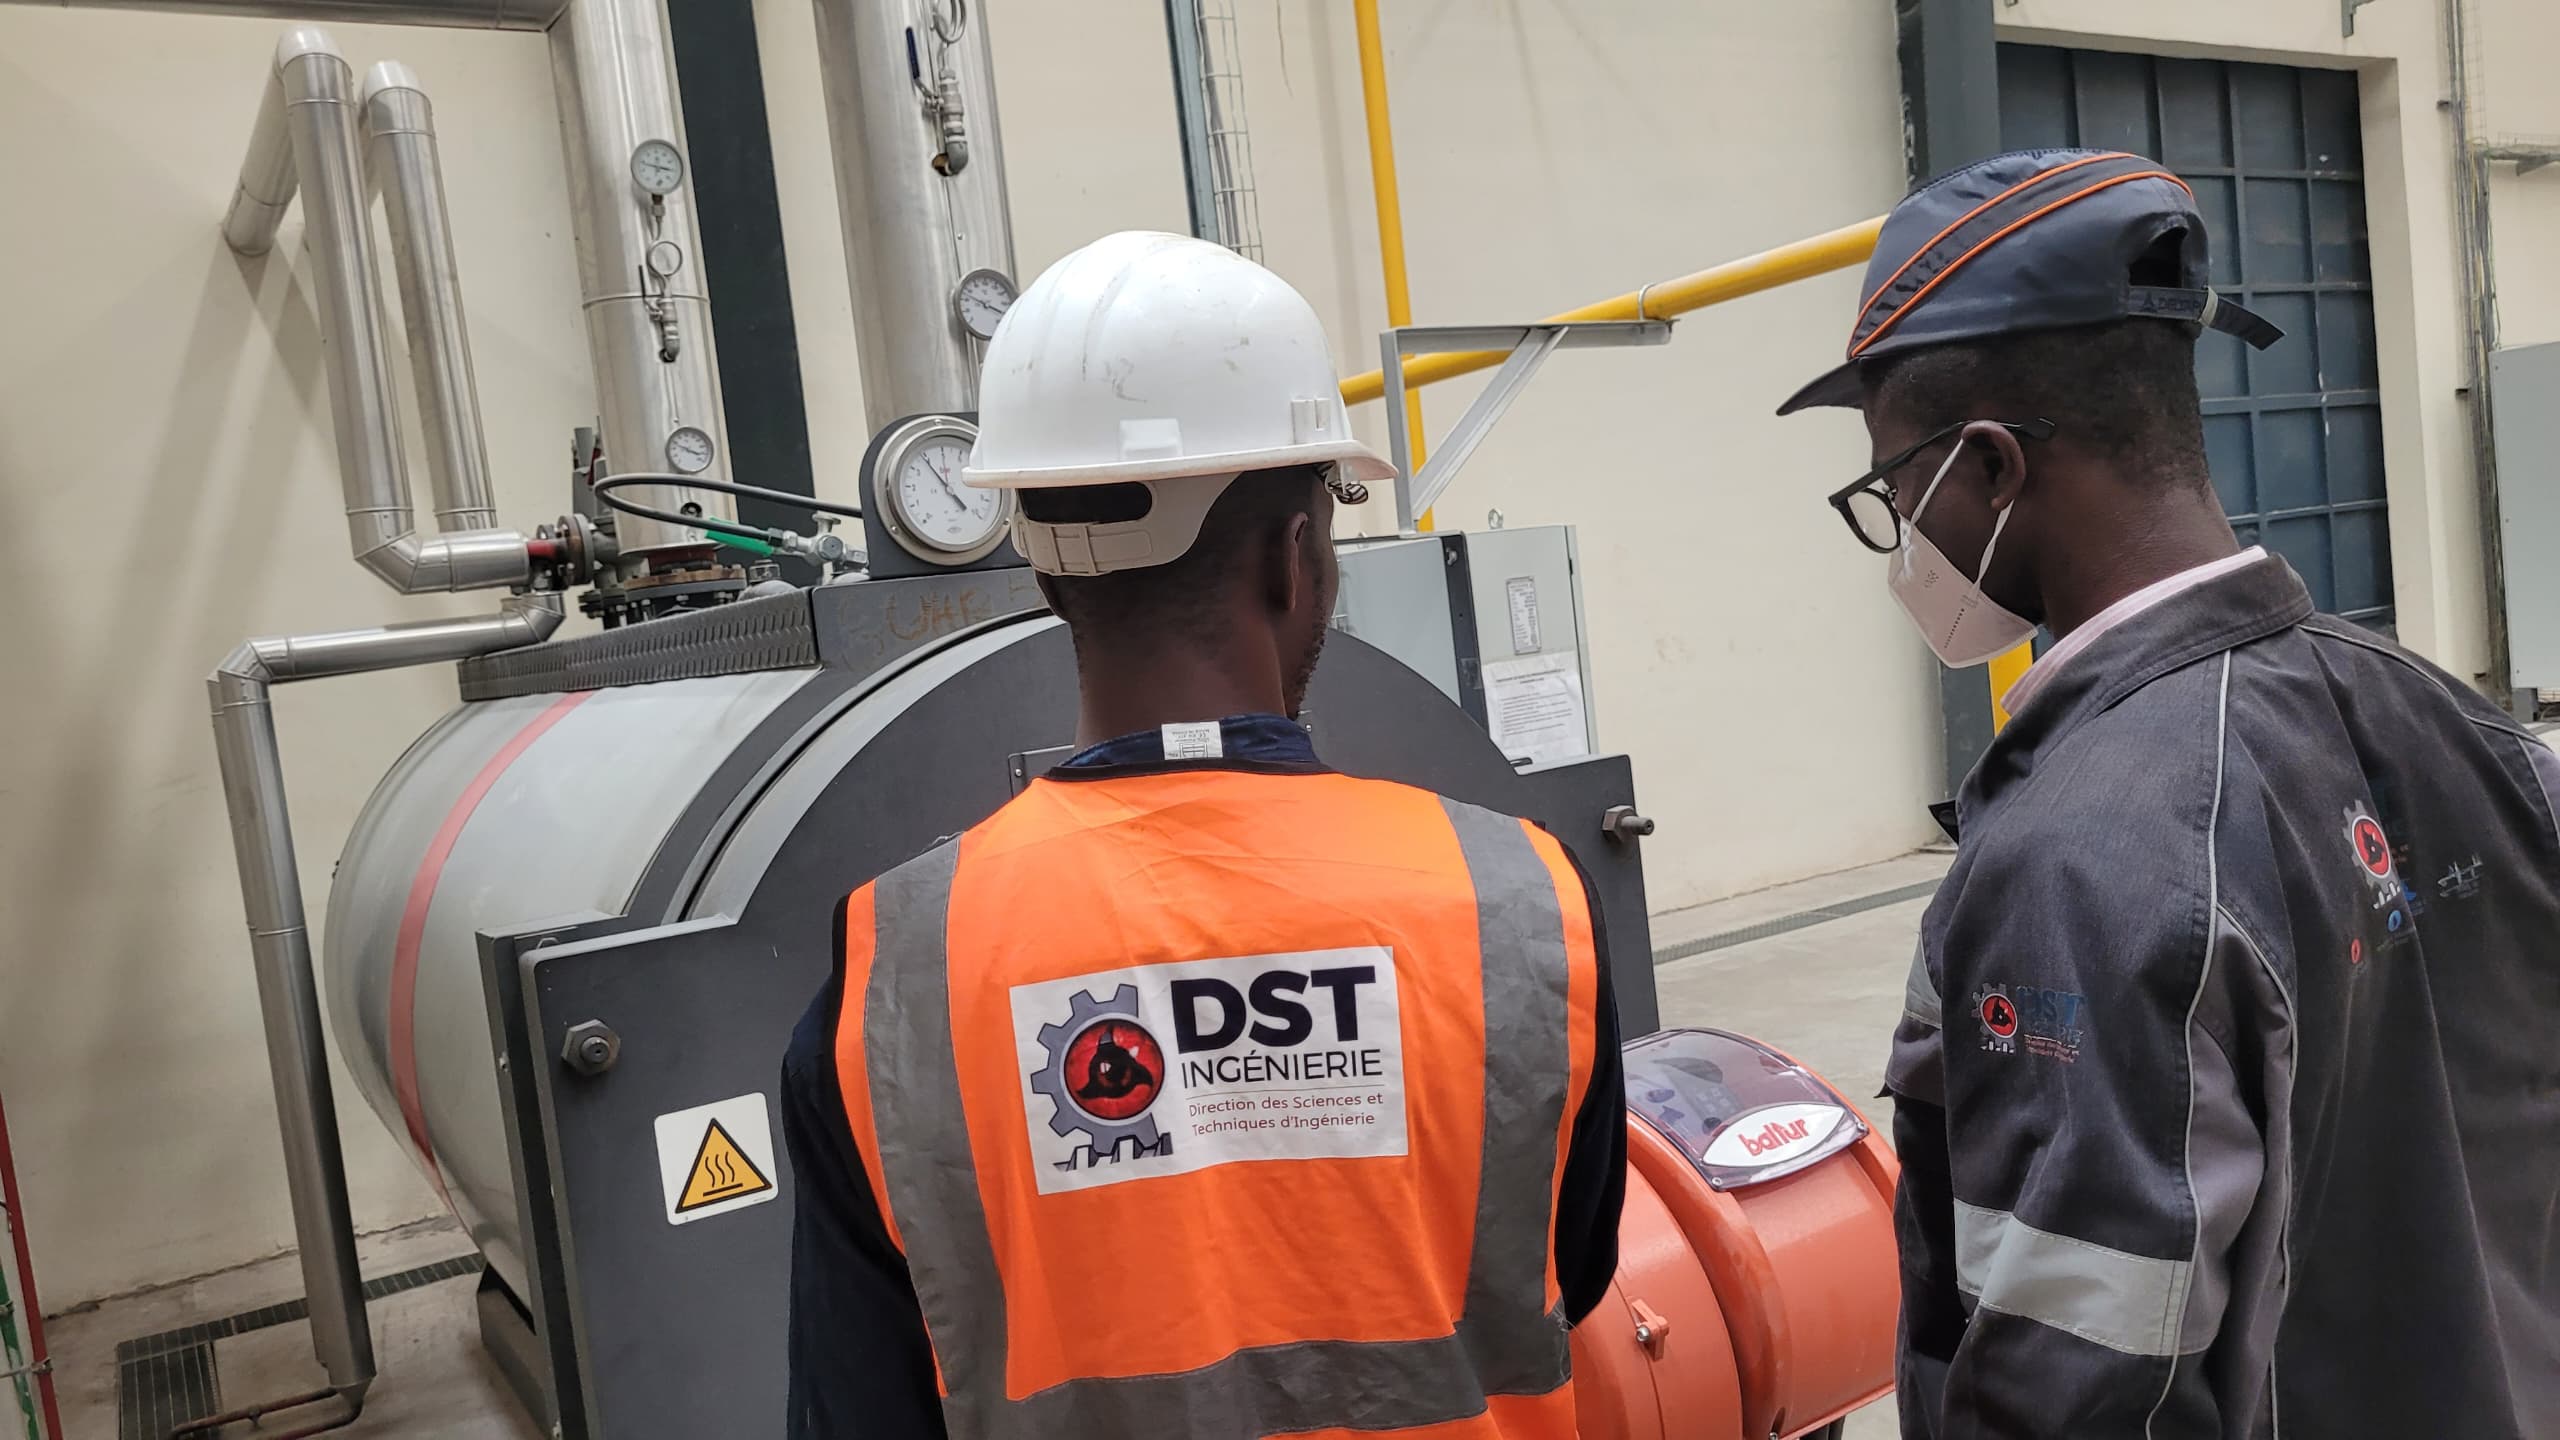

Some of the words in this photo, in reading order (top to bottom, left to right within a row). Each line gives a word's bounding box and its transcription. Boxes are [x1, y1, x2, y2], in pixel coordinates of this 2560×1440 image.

[1170, 965, 1376, 1054] DST
[1181, 1049, 1382, 1089] INGÉNIERIE
[1188, 1098, 1256, 1117] Direction
[1261, 1096, 1288, 1110] des
[1293, 1094, 1361, 1109] Sciences
[1367, 1093, 1384, 1105] et
[1191, 1117, 1276, 1137] Techniques
[1280, 1112, 1375, 1130] d'Ingénierie
[1738, 1118, 1809, 1157] baltur
